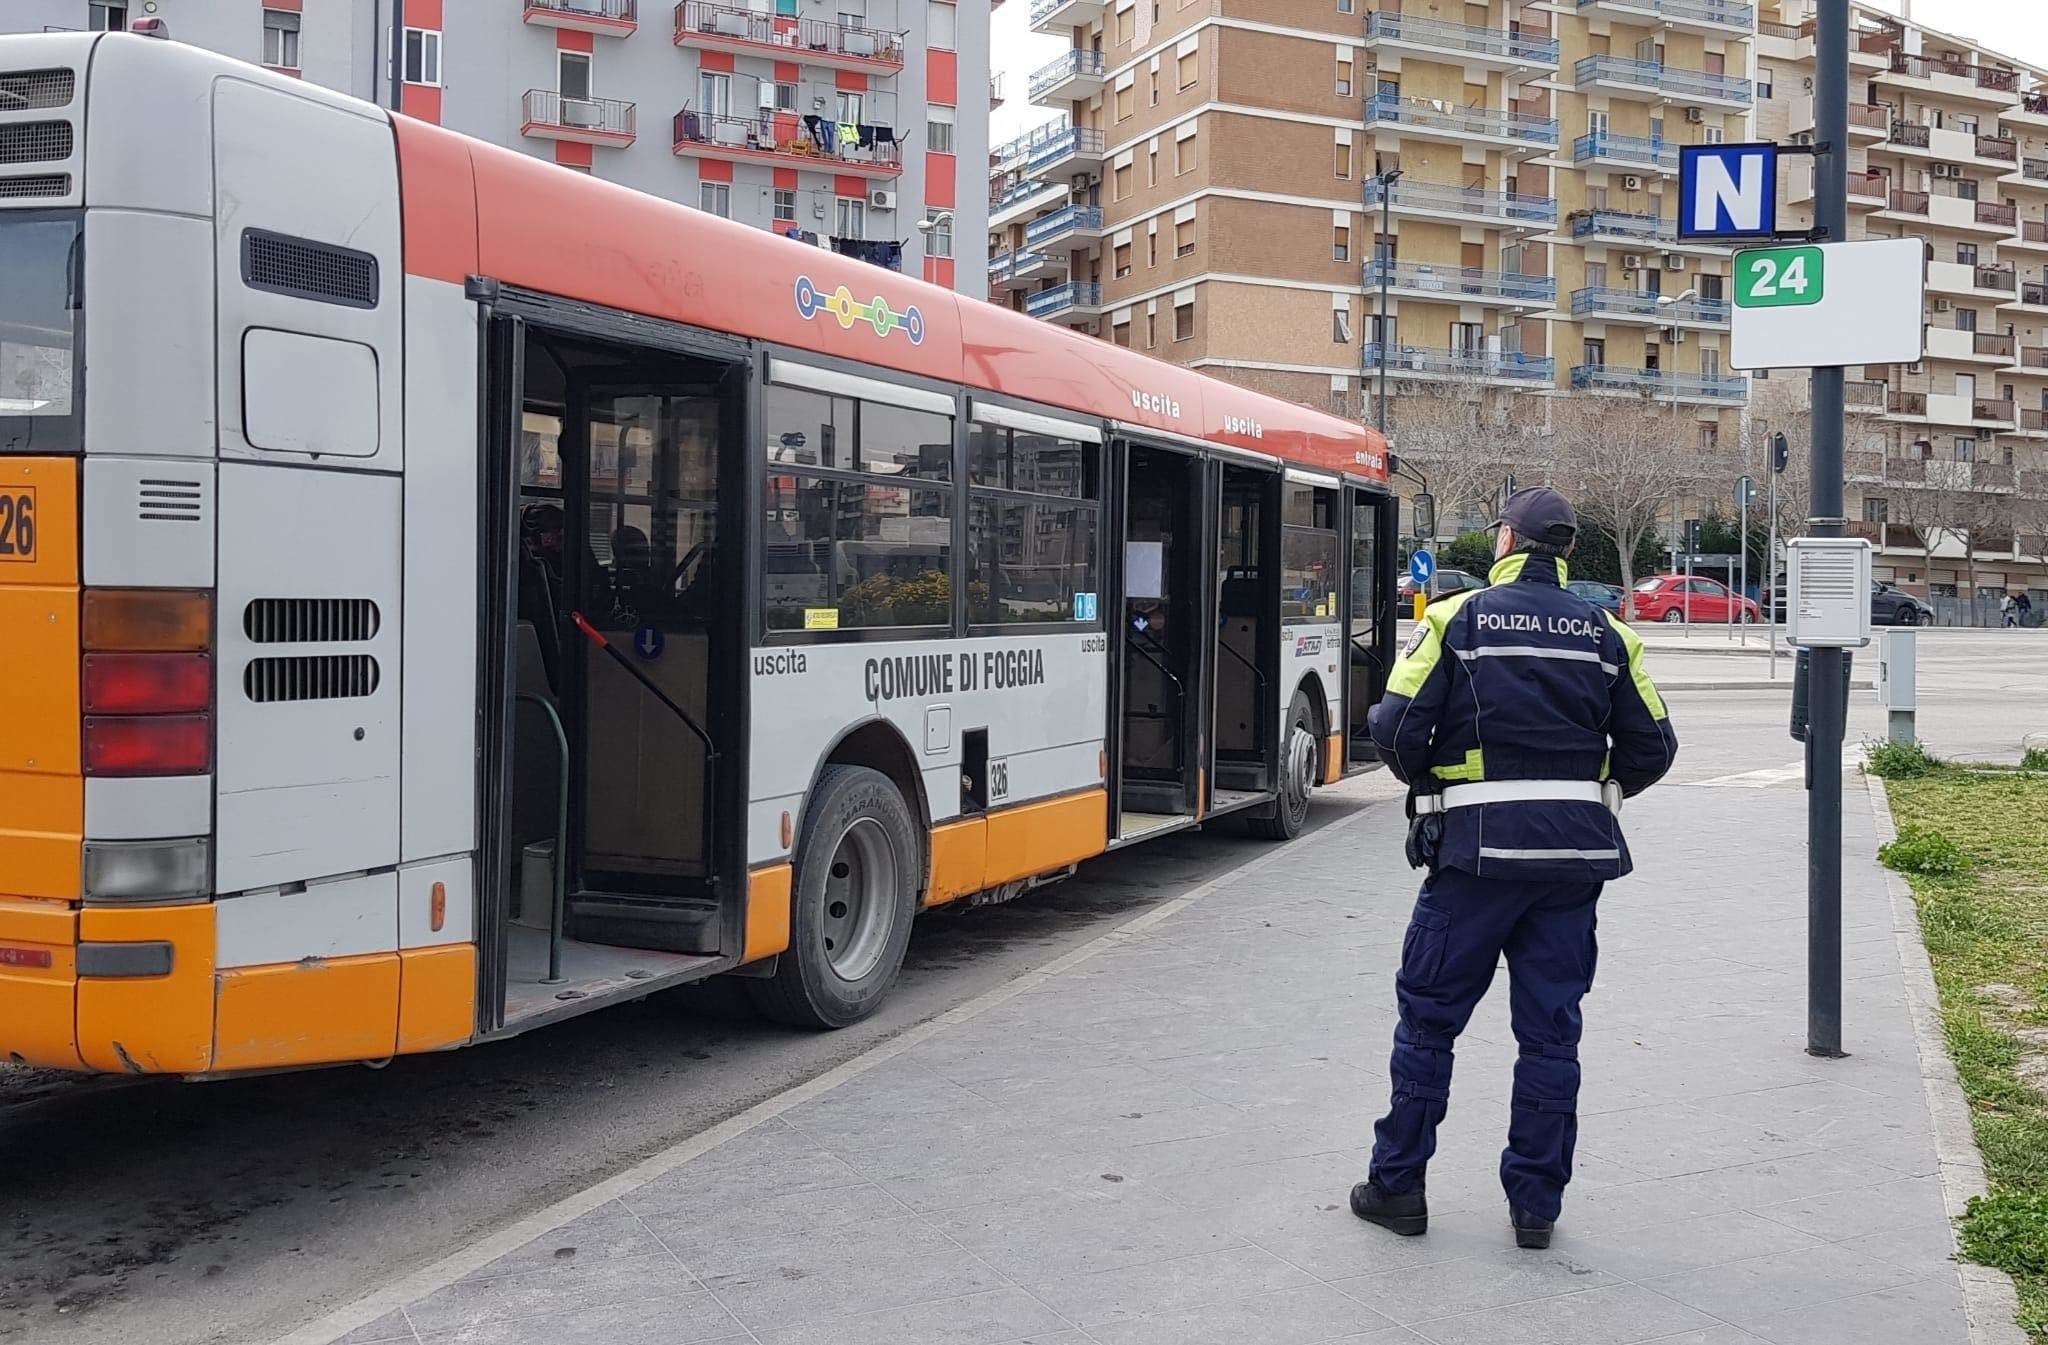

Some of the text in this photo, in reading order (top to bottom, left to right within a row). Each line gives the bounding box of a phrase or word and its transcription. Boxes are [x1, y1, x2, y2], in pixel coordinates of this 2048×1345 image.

[1694, 154, 1763, 230] N
[1750, 256, 1808, 297] 24
[1132, 389, 1180, 418] uscita
[1223, 415, 1263, 439] uscita
[1355, 450, 1383, 470] entrata
[0, 494, 33, 556] 26
[1081, 635, 1105, 653] uscita
[1476, 613, 1604, 644] POLIZIA LOCAE
[754, 648, 807, 676] uscita
[865, 649, 1044, 702] COMUNE DI FOGGIA
[991, 762, 1008, 797] 326
